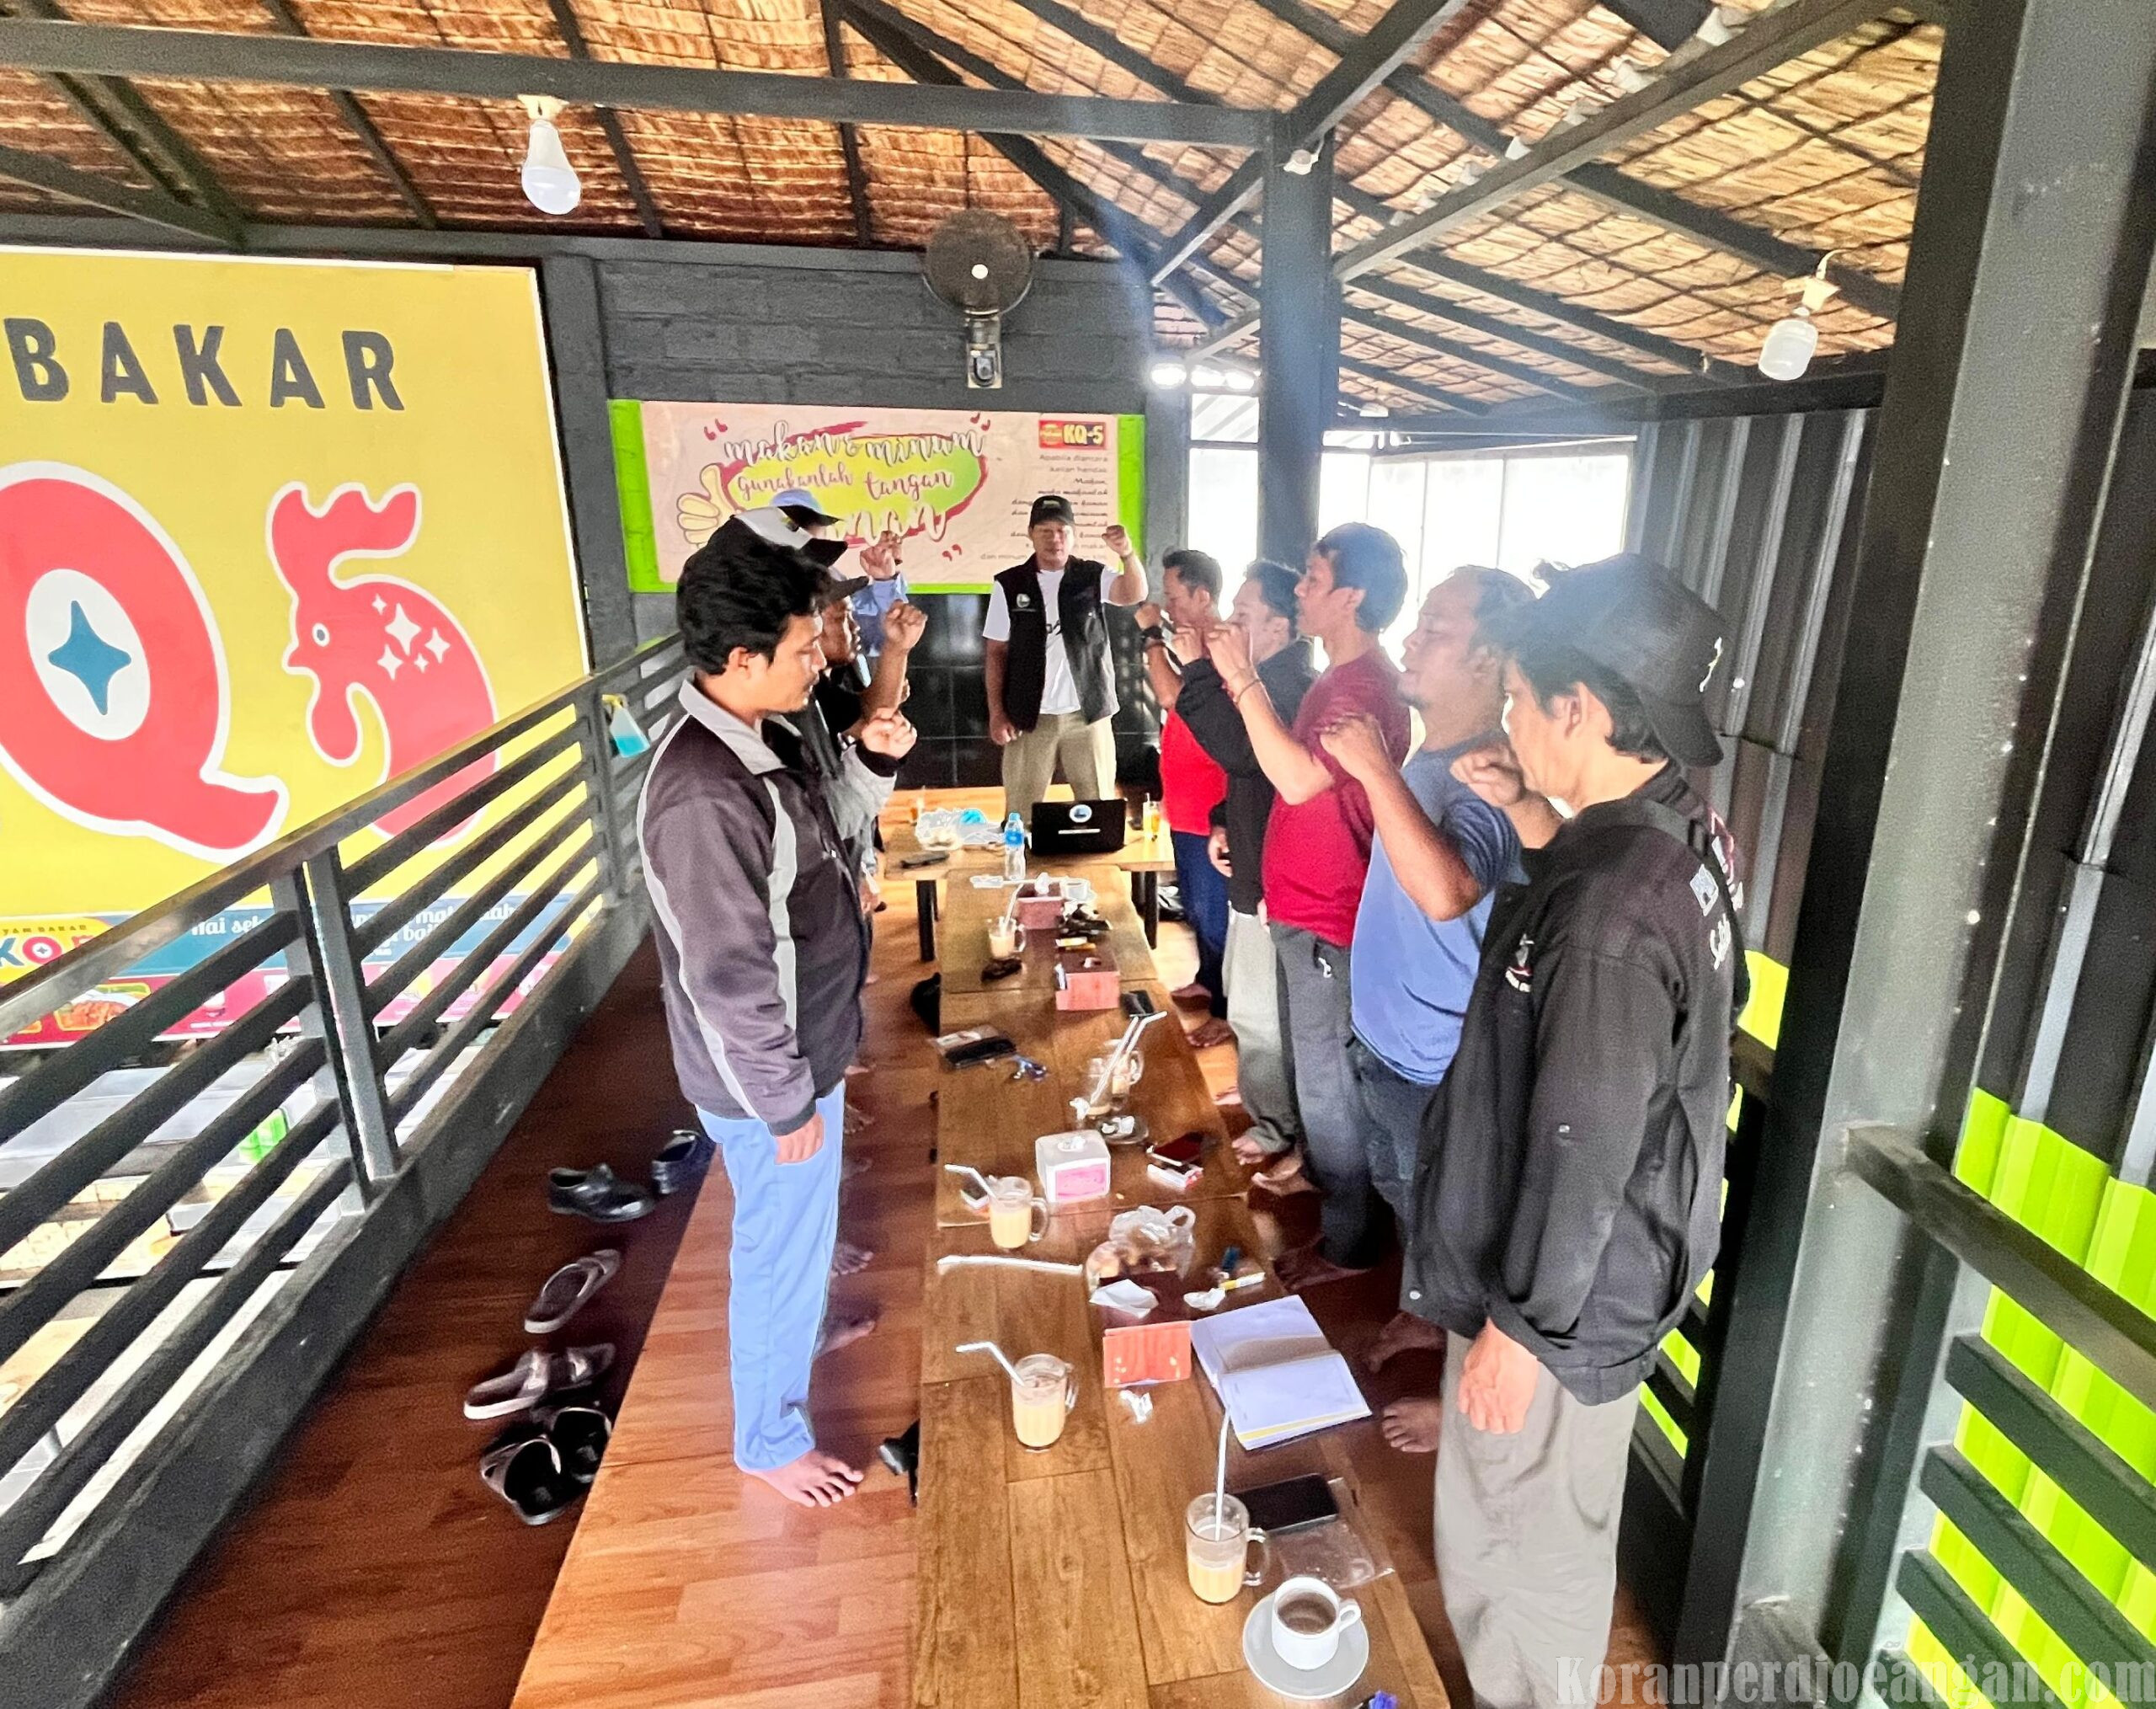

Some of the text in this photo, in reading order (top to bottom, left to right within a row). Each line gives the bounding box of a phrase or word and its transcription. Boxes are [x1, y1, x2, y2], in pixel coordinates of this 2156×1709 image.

[3, 317, 405, 411] BAKAR
[723, 420, 841, 467] makan
[864, 429, 986, 467] minum
[864, 469, 955, 501] tangan
